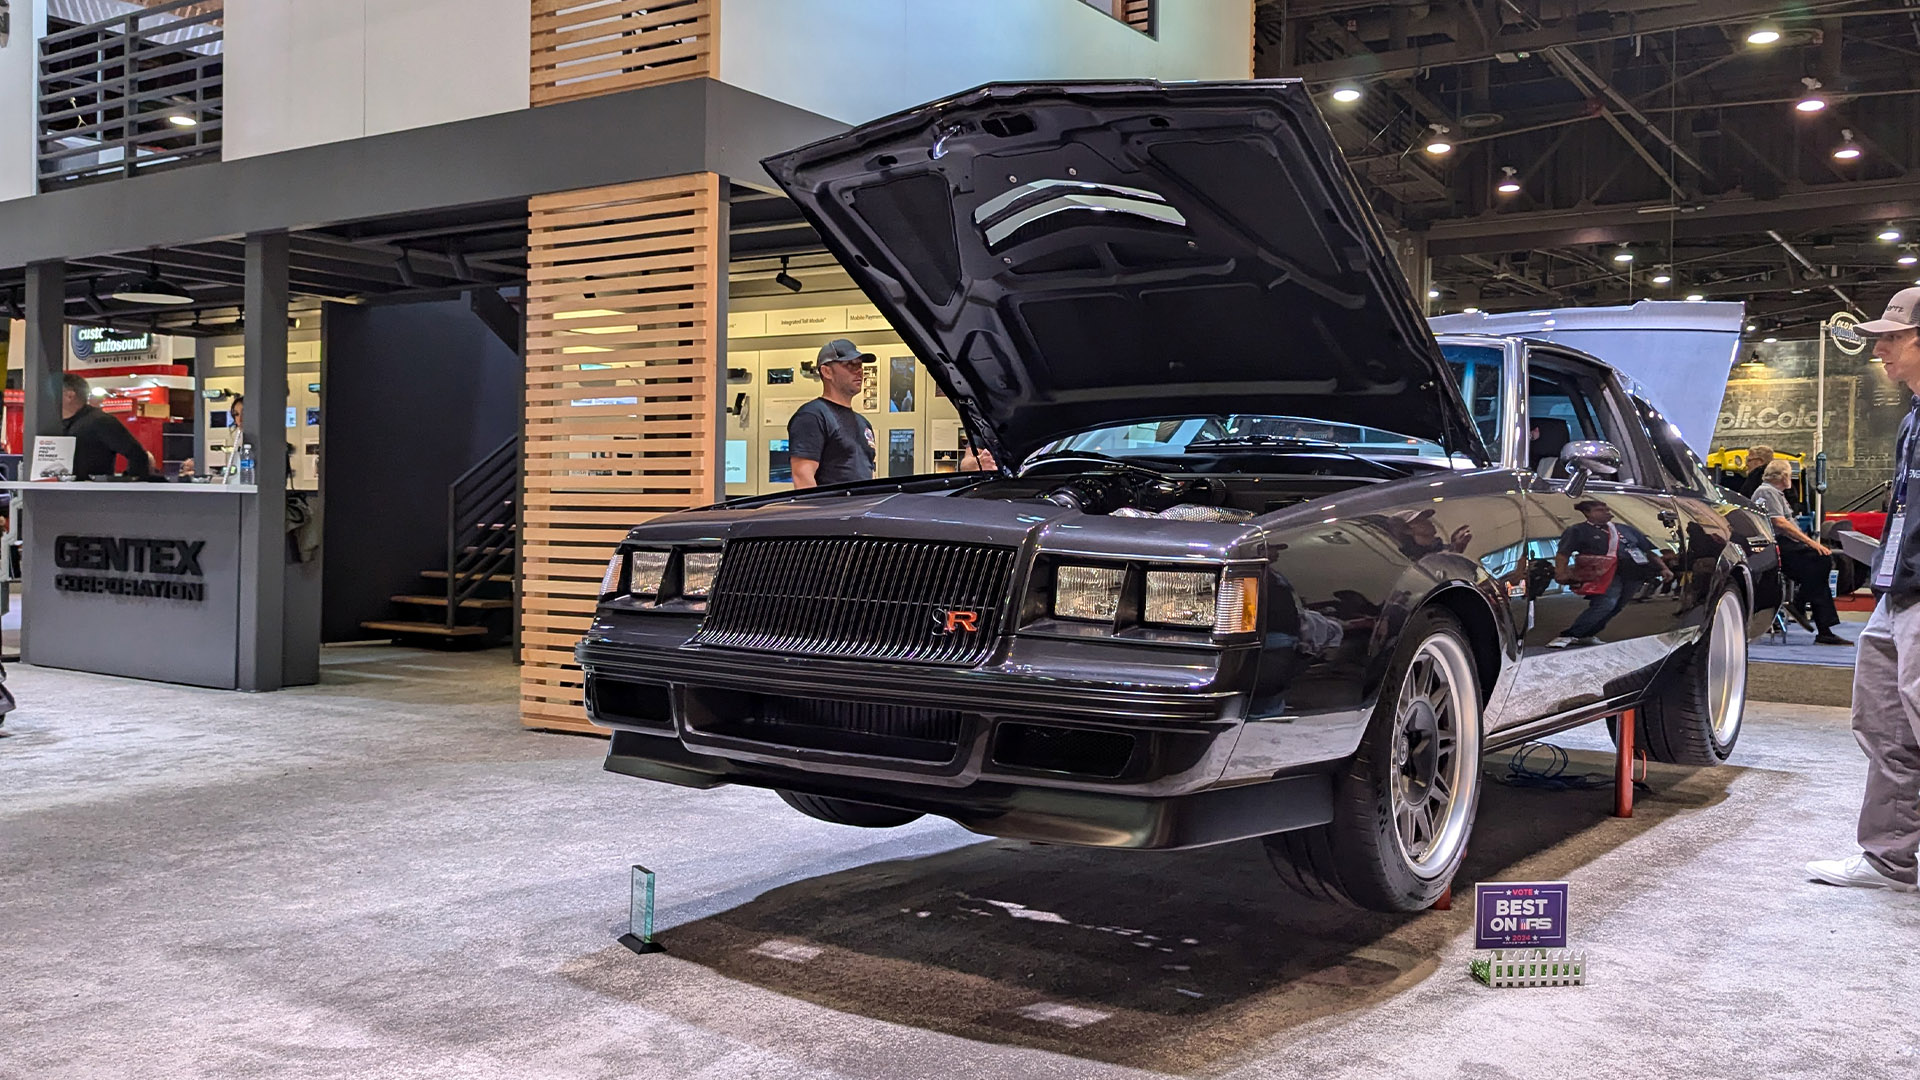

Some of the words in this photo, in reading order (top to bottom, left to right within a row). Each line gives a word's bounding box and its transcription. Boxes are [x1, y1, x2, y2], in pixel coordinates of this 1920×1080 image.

[94, 333, 148, 353] autosound
[55, 535, 206, 576] GENTEX
[55, 574, 204, 602] CORPORATION
[1512, 888, 1533, 896] VOTE
[1495, 899, 1548, 916] BEST
[1490, 917, 1517, 932] ON
